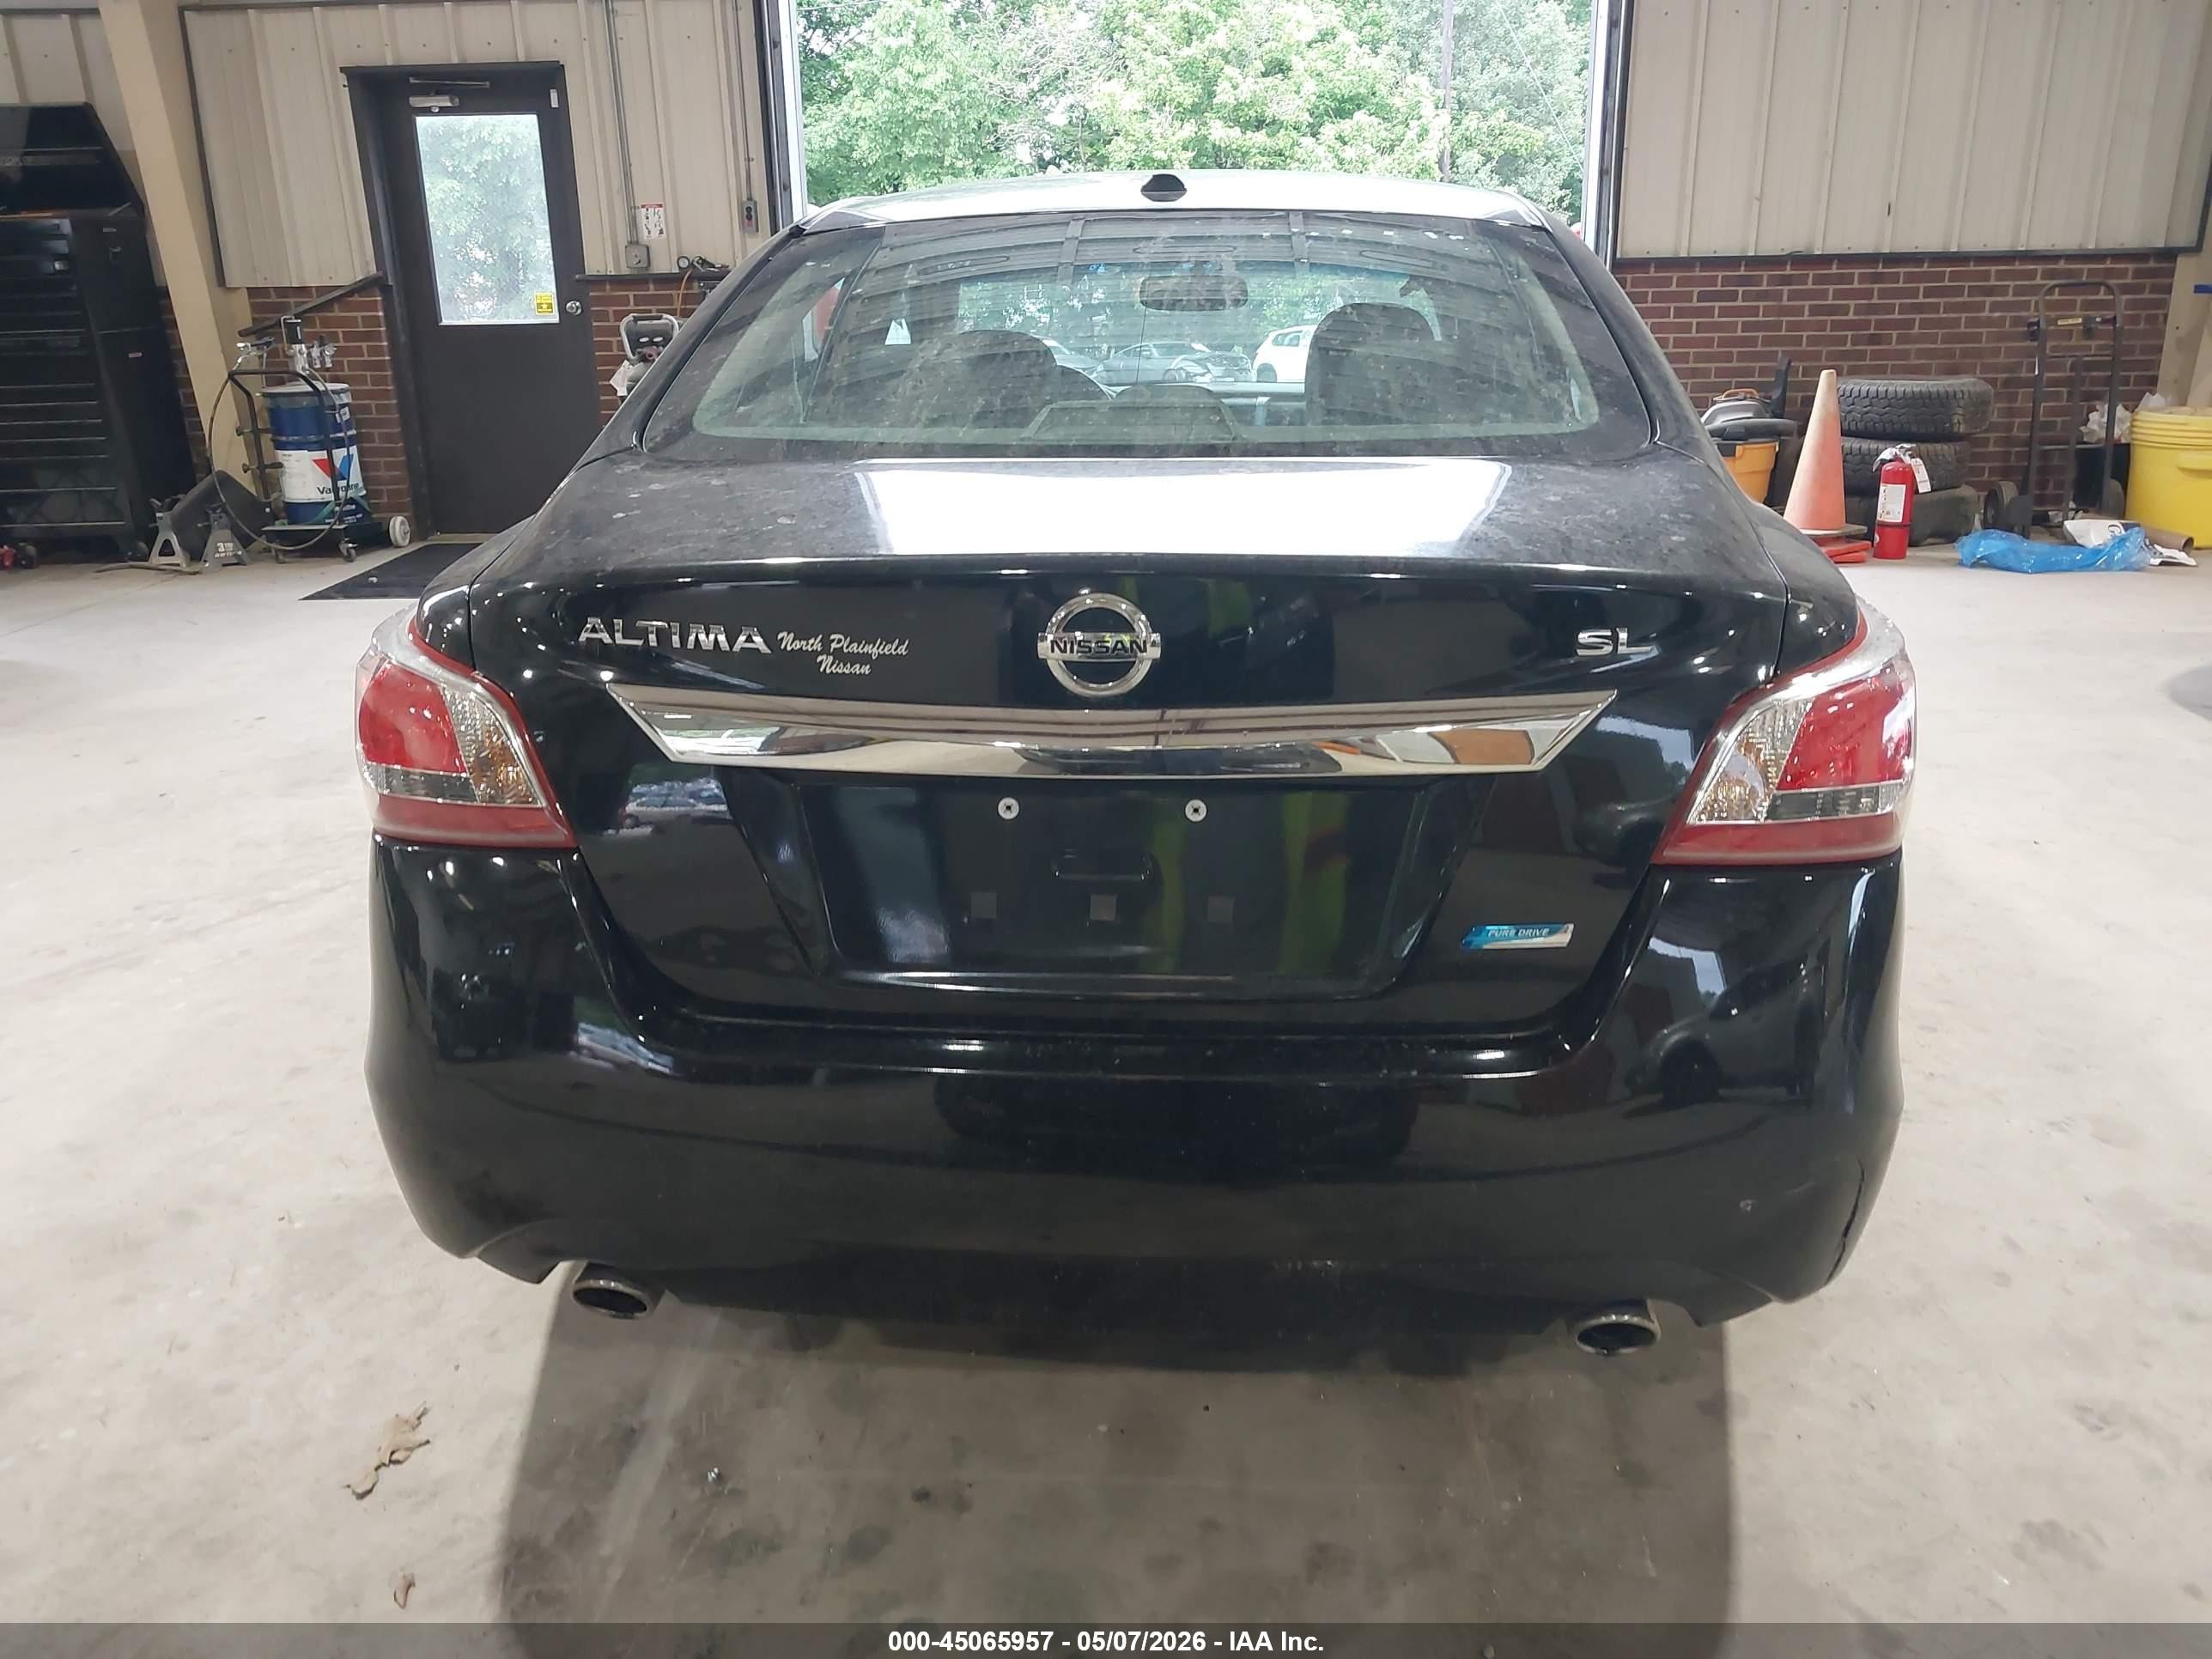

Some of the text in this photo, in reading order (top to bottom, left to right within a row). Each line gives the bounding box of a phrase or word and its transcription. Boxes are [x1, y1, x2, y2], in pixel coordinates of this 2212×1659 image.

[577, 617, 772, 654] ALTIMA
[776, 631, 909, 660] North Plainfield
[1049, 639, 1148, 654] NISSAN
[1576, 627, 1652, 656] SL
[816, 653, 872, 676] Nissan
[1487, 927, 1552, 938] PURE DRIVE
